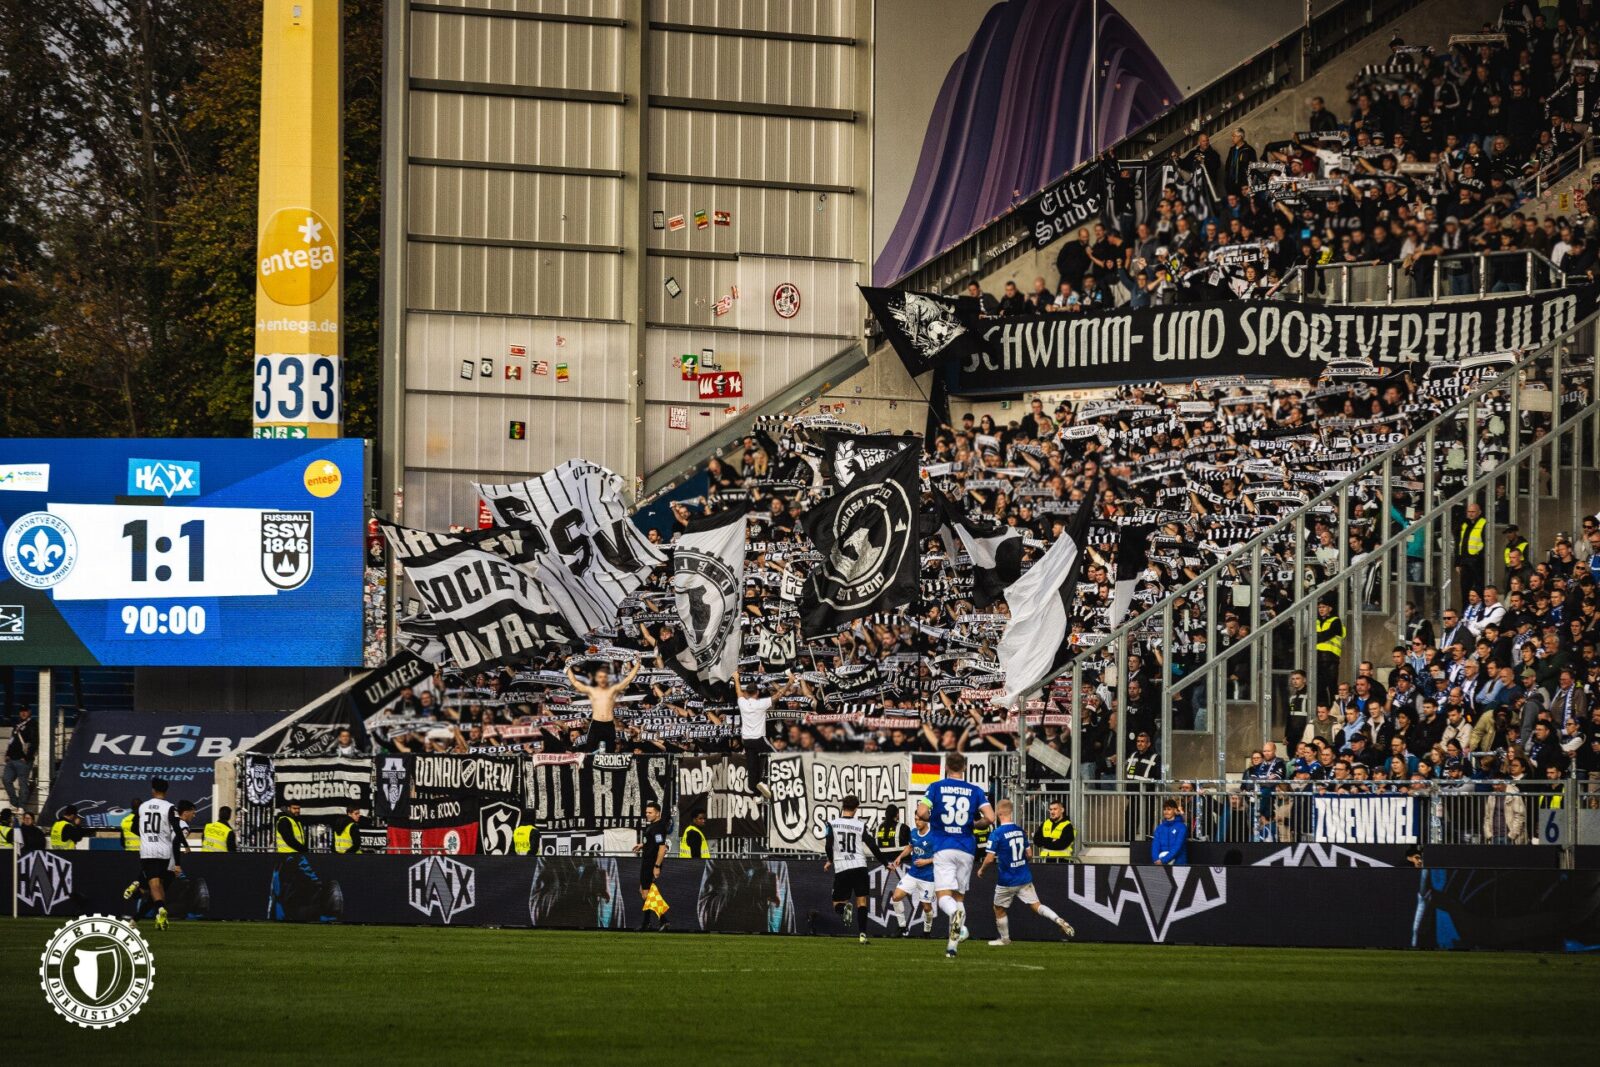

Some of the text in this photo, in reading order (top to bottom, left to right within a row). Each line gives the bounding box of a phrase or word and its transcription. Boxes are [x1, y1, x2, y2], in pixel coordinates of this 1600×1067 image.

[1040, 178, 1088, 216] Elite
[1035, 193, 1101, 245] Sende
[261, 245, 334, 276] entega
[266, 319, 337, 333] entega.de
[1153, 308, 1226, 362] UND
[1237, 306, 1482, 364] SPORTVEREIN
[1495, 294, 1577, 353] ULM
[865, 454, 887, 468] 1846
[307, 474, 339, 487] entega
[15, 516, 68, 535] SPORTVEREIN
[263, 514, 309, 522] FUSSBALL
[263, 523, 309, 538] SSV
[121, 519, 206, 582] 1:1
[262, 538, 309, 553] 1846
[856, 571, 885, 598] 2010
[121, 605, 206, 634] 90:00
[365, 659, 424, 704] ULMER
[469, 742, 541, 755] PRODIGS
[594, 754, 632, 767] PRODIGYS
[771, 757, 799, 782] SSV
[80, 771, 148, 782] UNSERER
[415, 756, 461, 788] DONAU
[476, 758, 515, 793] CREW
[812, 761, 906, 803] BACHTAL
[283, 780, 362, 801] constante
[771, 779, 804, 802] 1846
[940, 786, 973, 797] DARMSTADT
[940, 795, 971, 827] 38
[1315, 797, 1417, 844] ZWEWWEL
[143, 812, 162, 835] 20
[1545, 811, 1560, 842] 6
[837, 831, 857, 854] 30
[1008, 837, 1025, 861] 17
[922, 889, 930, 899] 2
